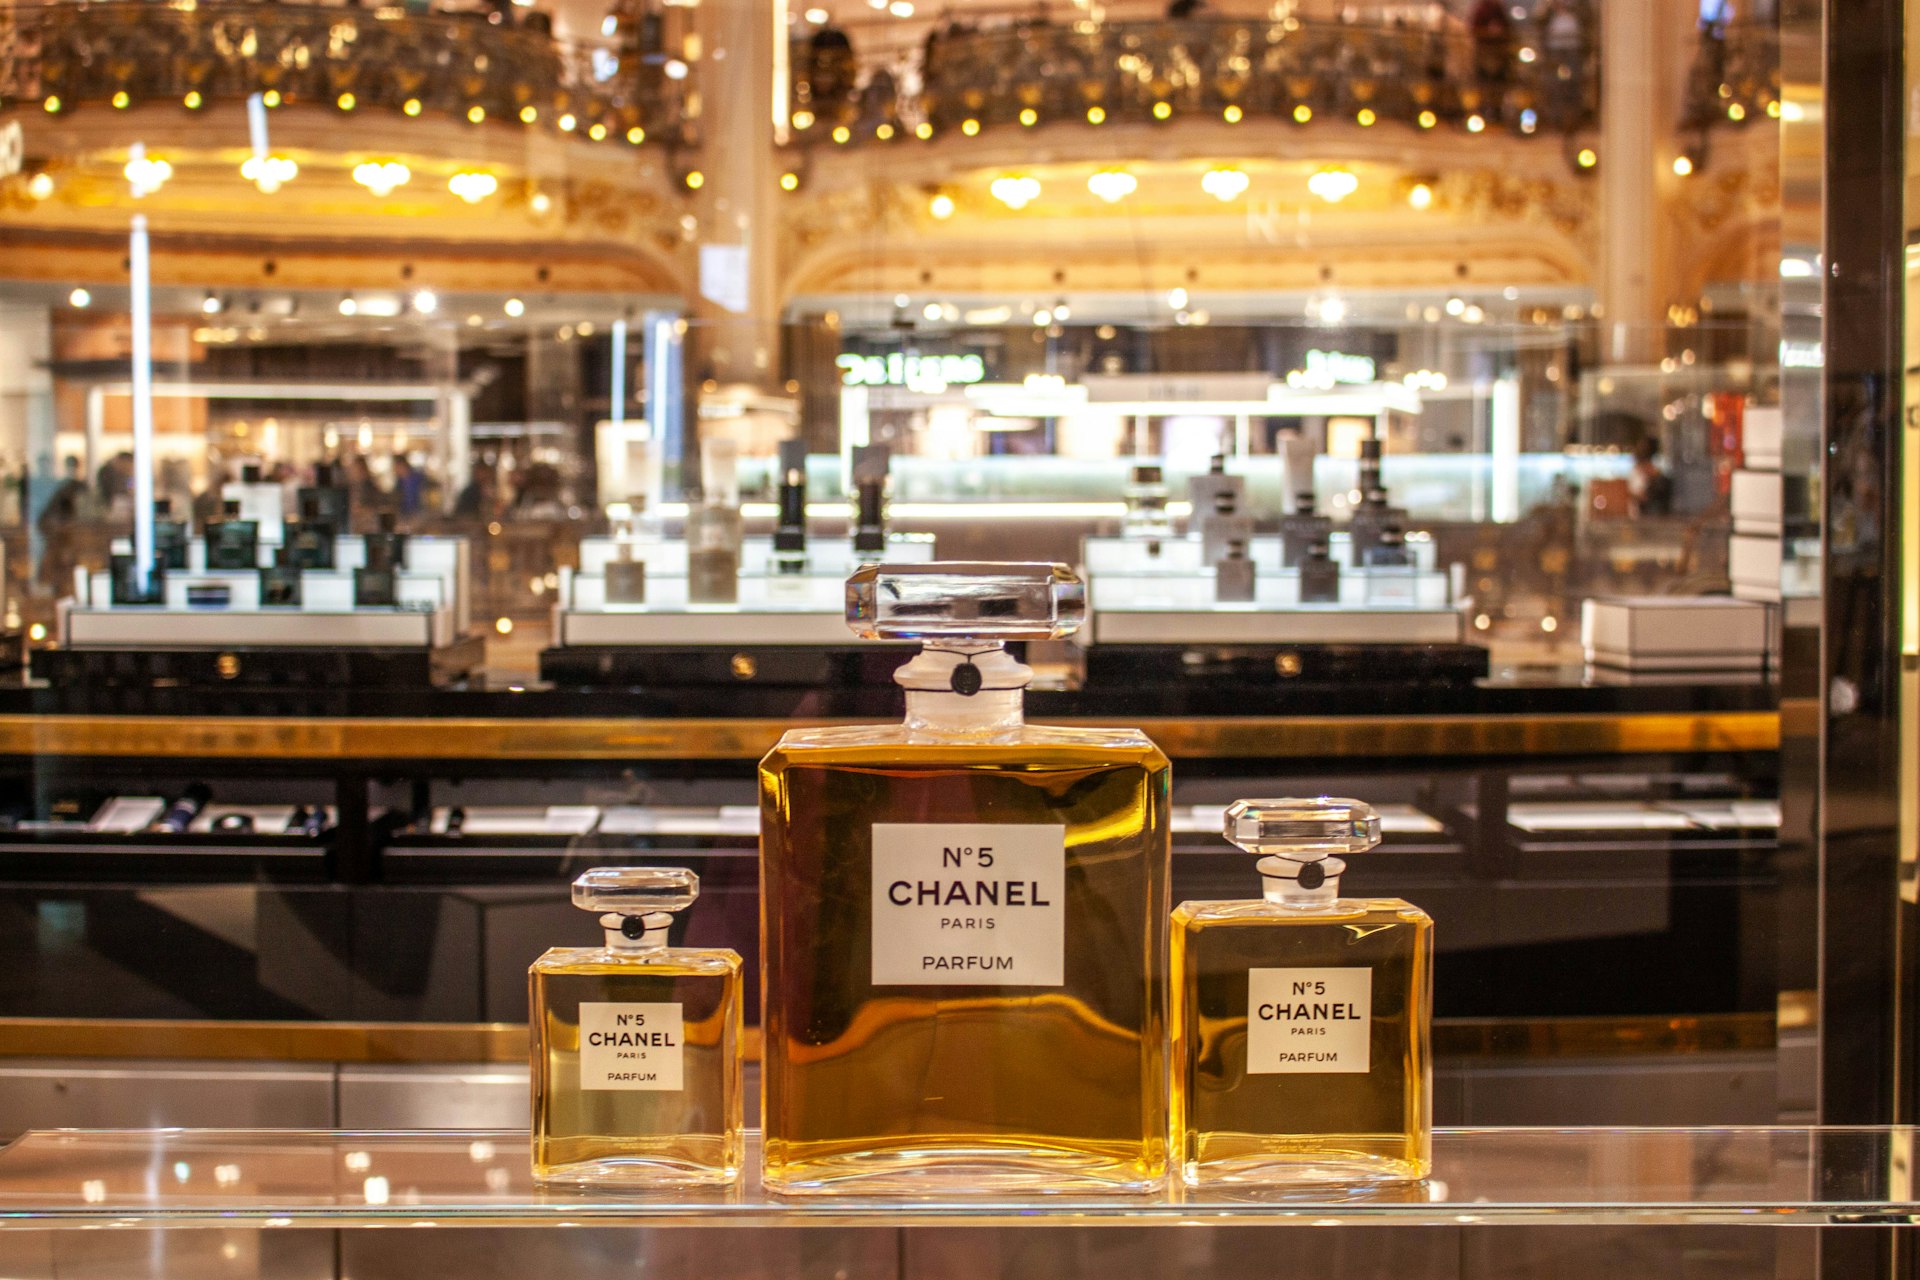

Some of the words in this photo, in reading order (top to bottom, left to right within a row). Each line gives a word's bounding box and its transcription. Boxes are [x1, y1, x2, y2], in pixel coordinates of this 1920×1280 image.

[887, 879, 1051, 907] CHANEL
[940, 917, 996, 930] PARIS
[922, 955, 1014, 971] PARFUM
[1257, 1002, 1362, 1021] CHANEL
[1290, 1026, 1327, 1036] PARIS
[588, 1031, 676, 1047] CHANEL
[616, 1051, 647, 1060] PARIS
[1278, 1052, 1339, 1063] PARFUM
[607, 1072, 657, 1081] PARFUM
